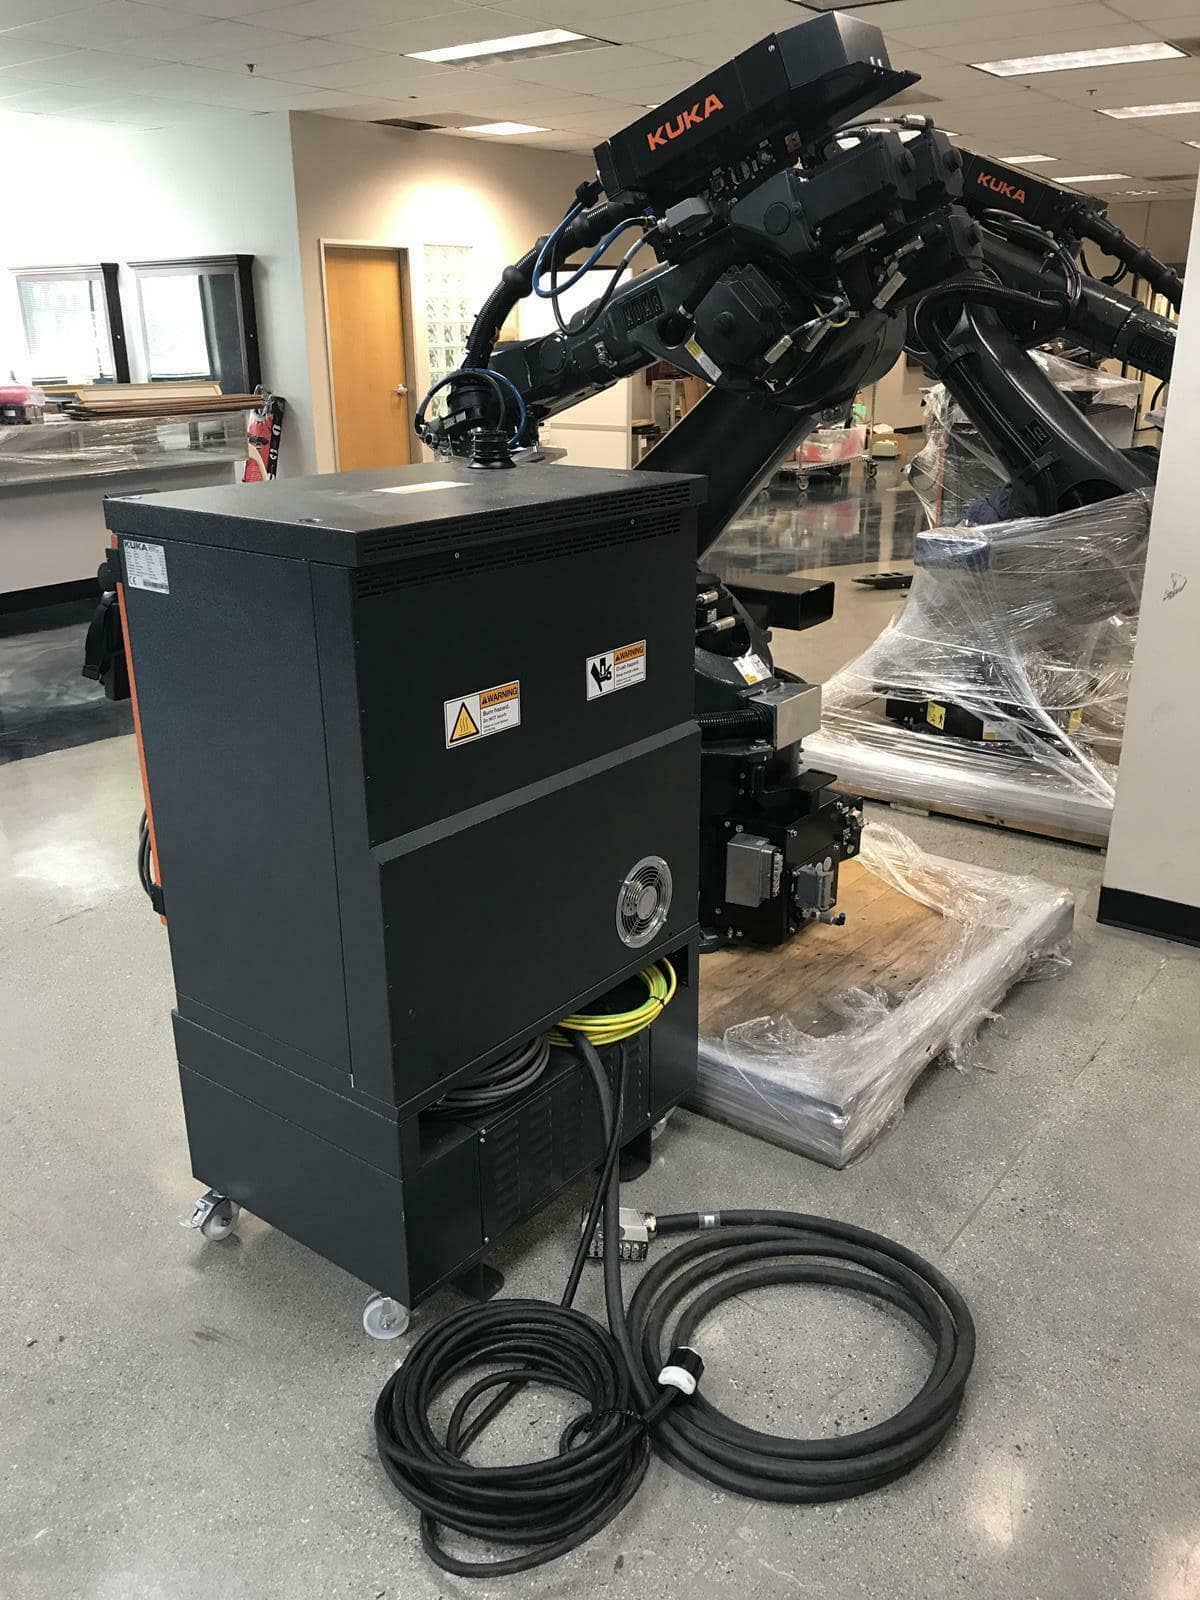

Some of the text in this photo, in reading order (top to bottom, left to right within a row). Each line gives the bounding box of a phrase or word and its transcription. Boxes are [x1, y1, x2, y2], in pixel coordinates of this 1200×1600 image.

[647, 94, 724, 151] KUKA
[977, 172, 1025, 204] KUKA
[124, 540, 148, 551] KUKA
[487, 687, 518, 702] WARNING
